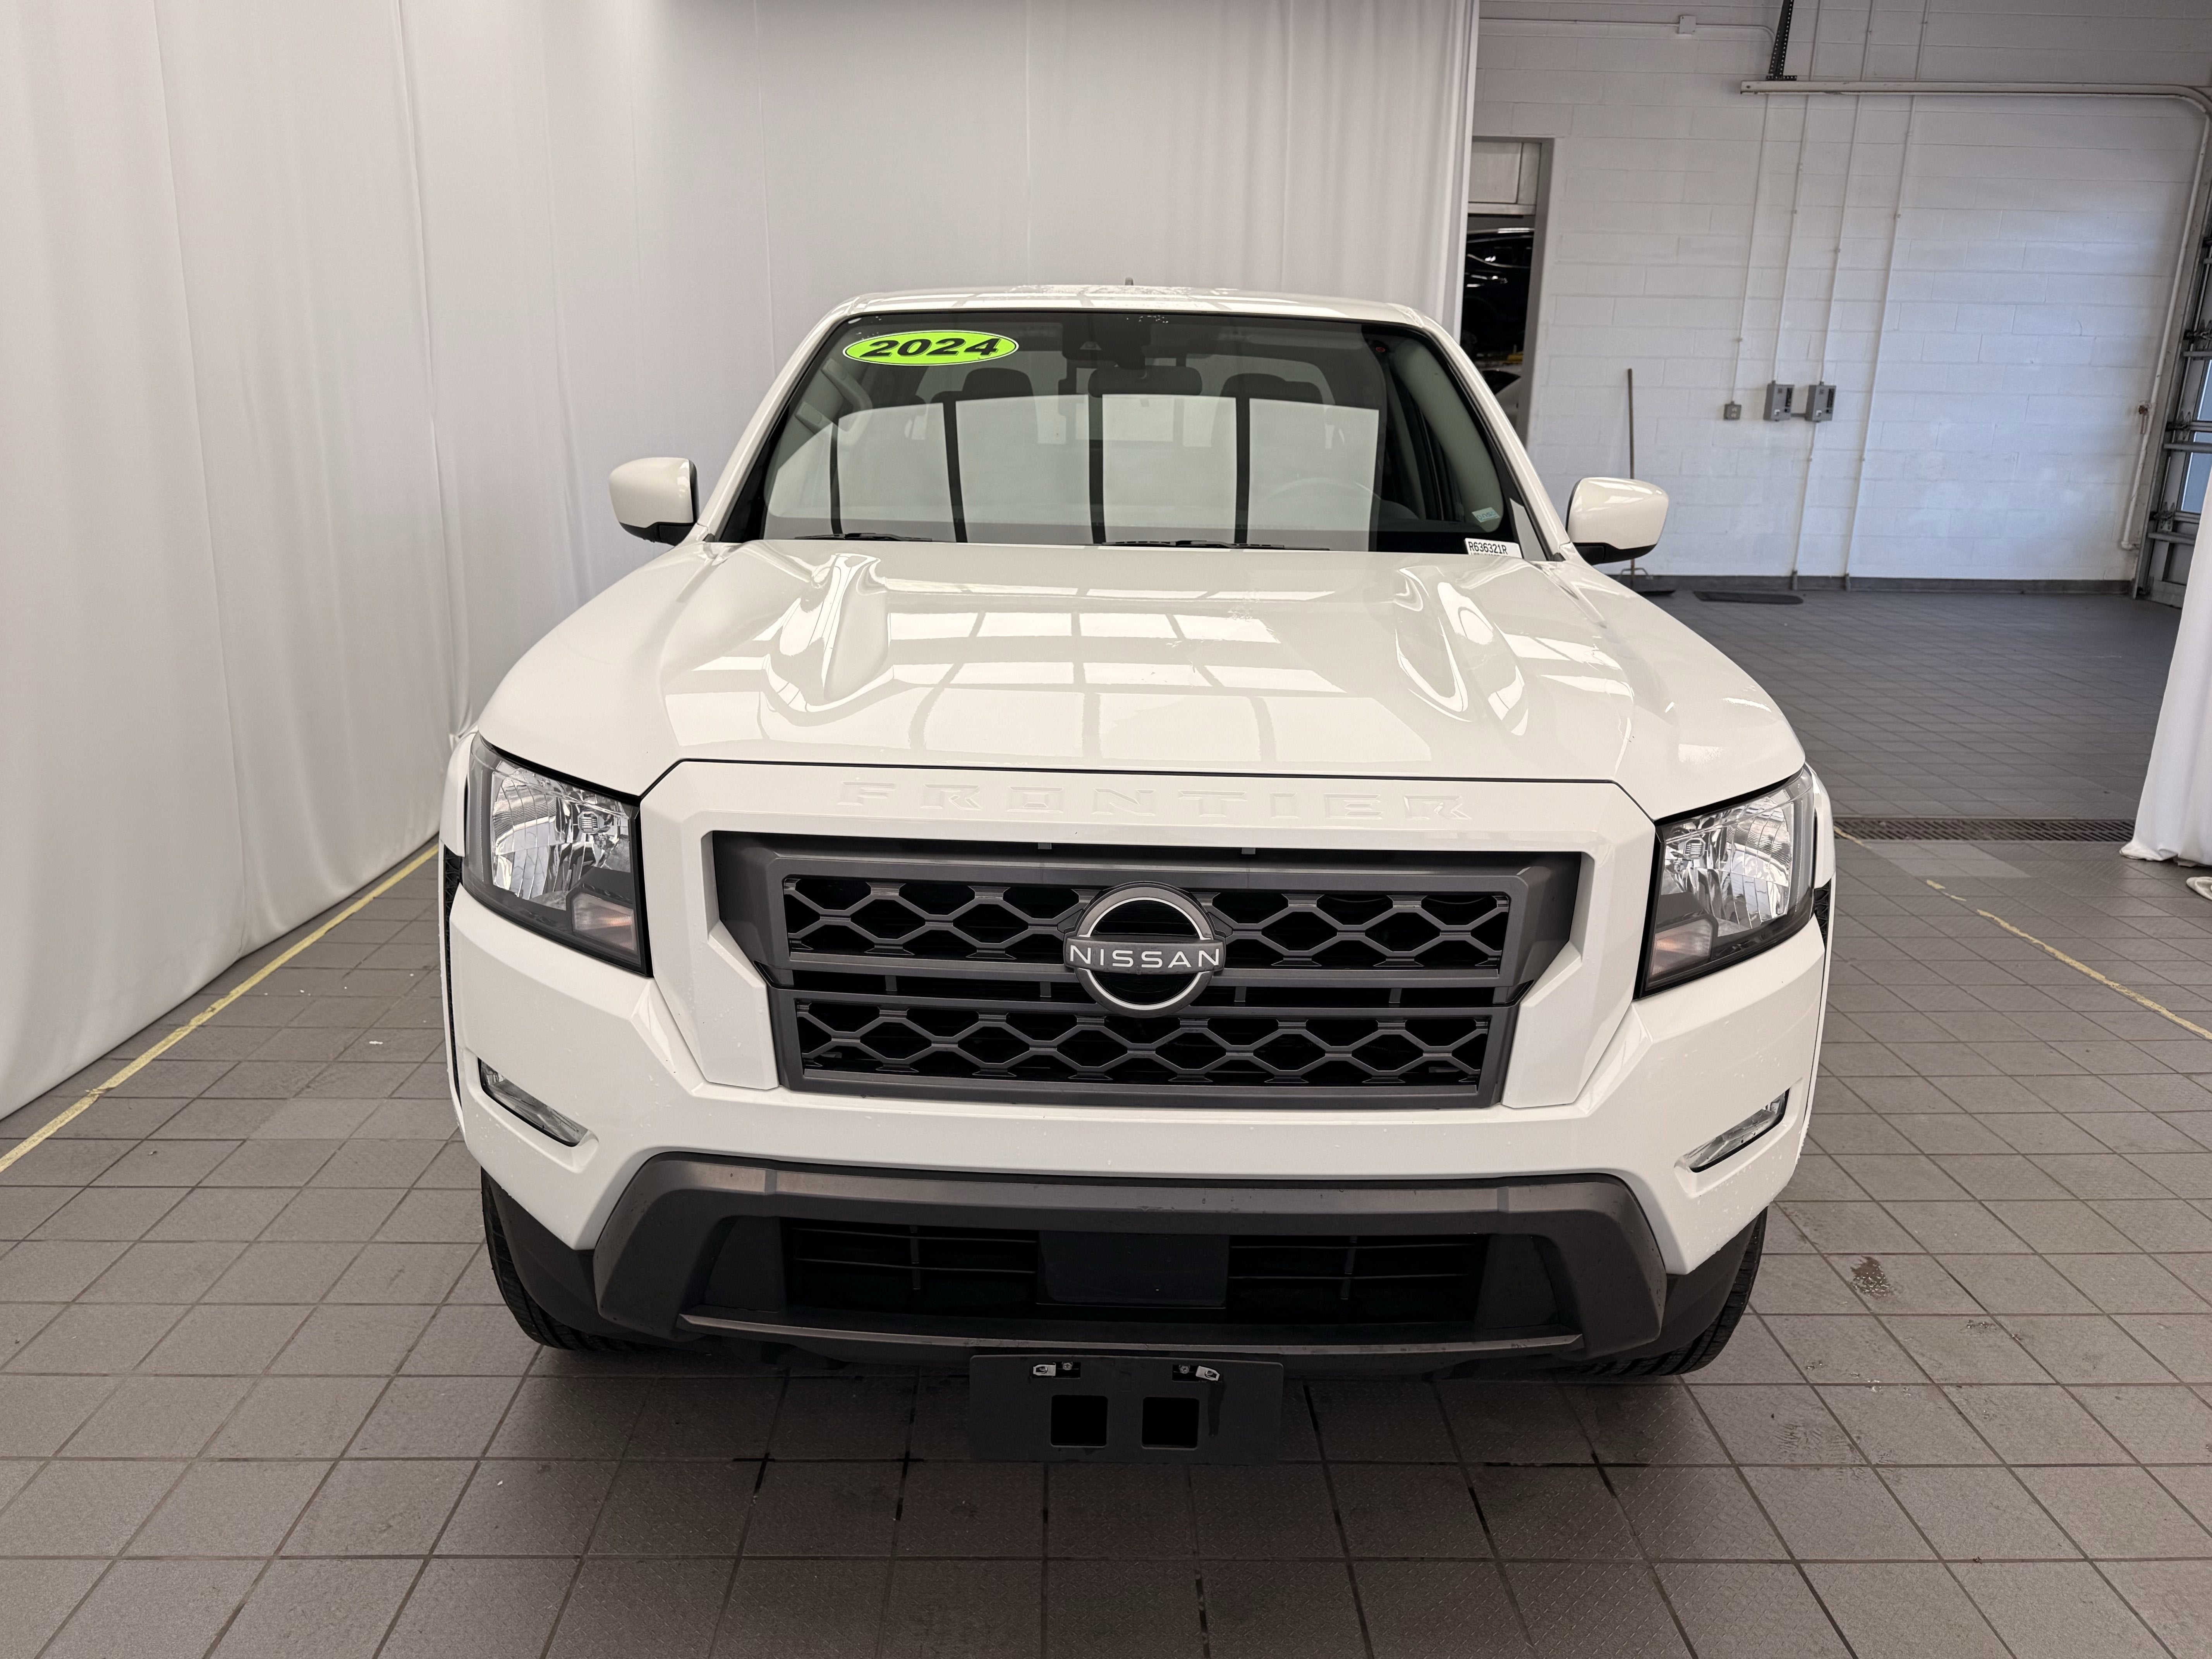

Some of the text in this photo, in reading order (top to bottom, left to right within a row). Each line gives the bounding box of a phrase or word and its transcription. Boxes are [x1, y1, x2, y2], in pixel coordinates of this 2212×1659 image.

[859, 338, 1002, 358] 2024
[1468, 541, 1508, 555] R636321R
[836, 782, 1472, 820] FRONTIER
[1070, 945, 1219, 968] NISSAN
